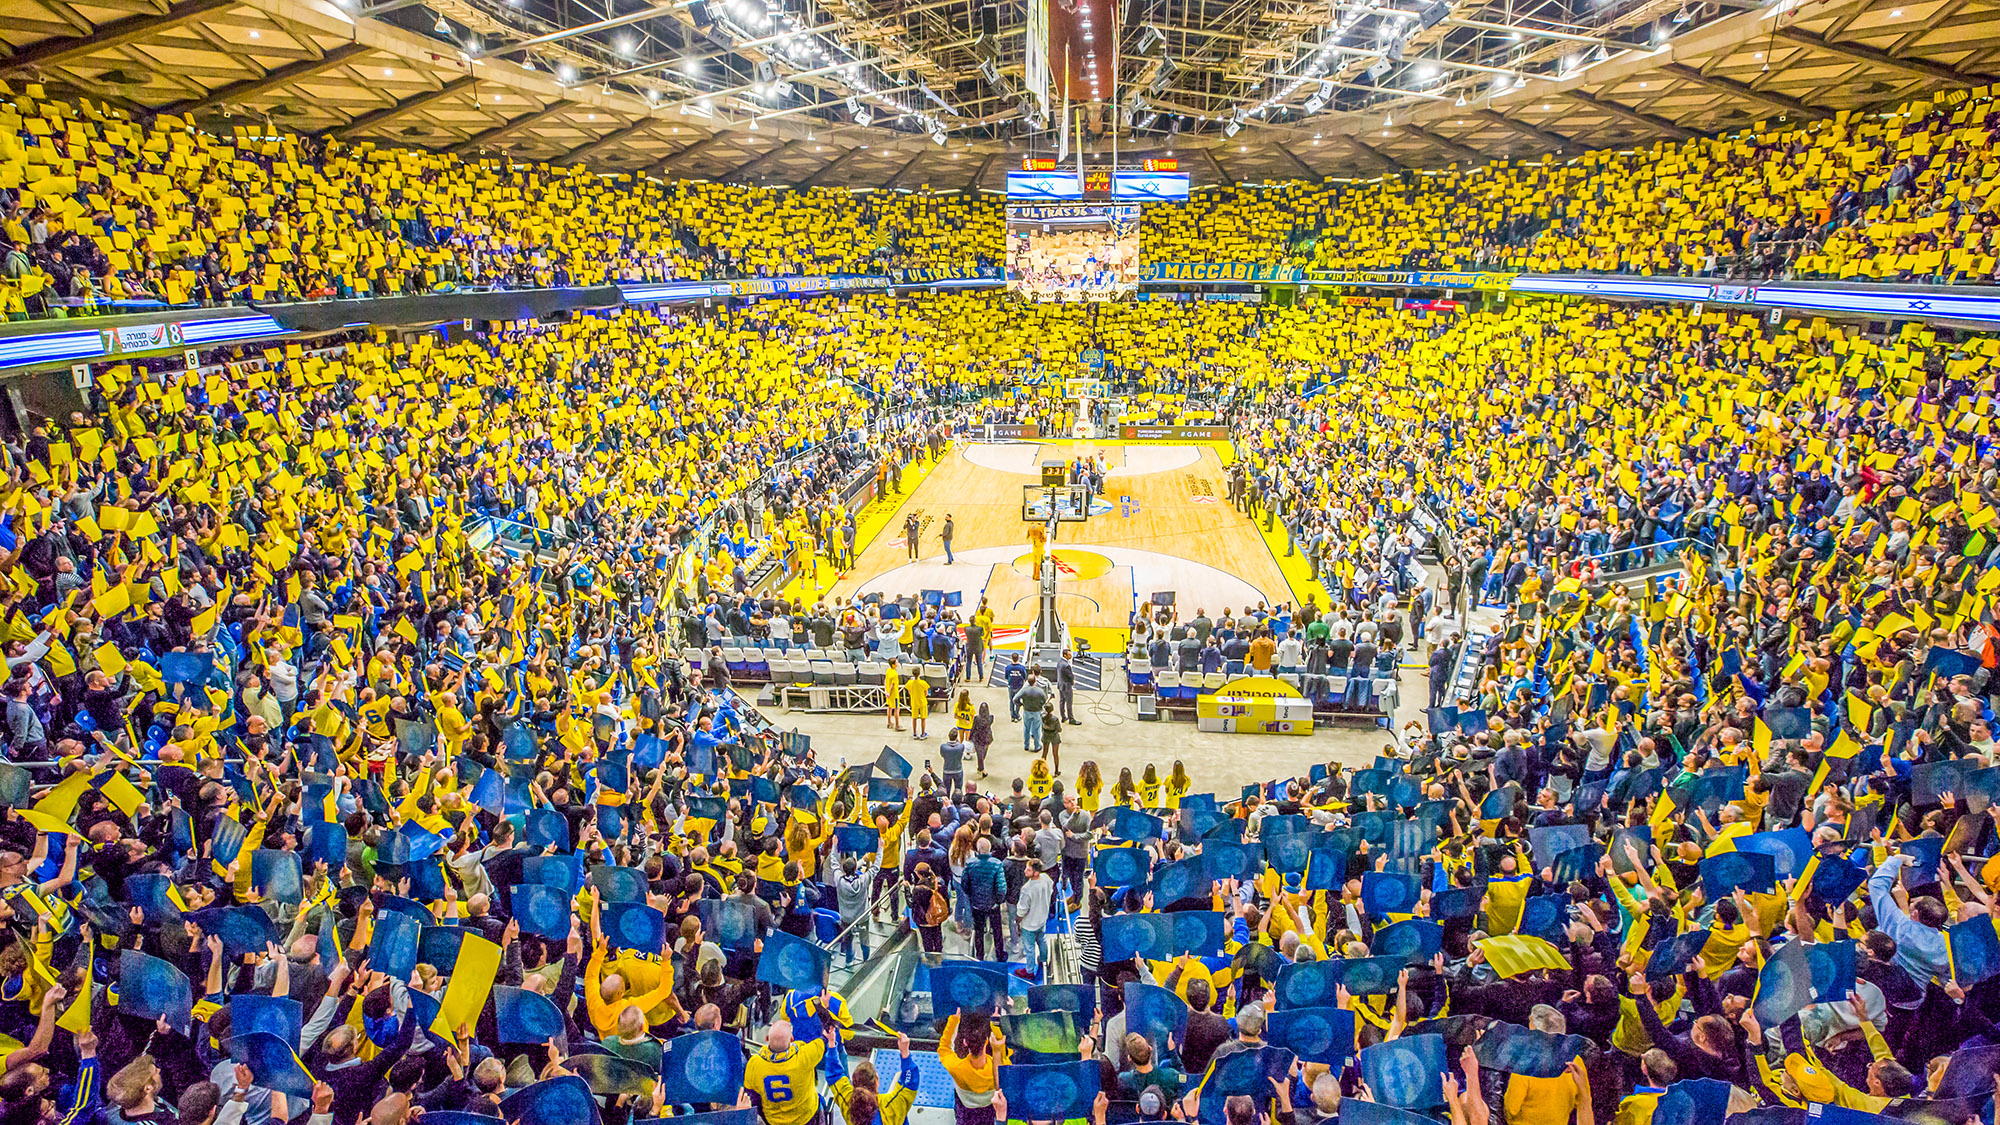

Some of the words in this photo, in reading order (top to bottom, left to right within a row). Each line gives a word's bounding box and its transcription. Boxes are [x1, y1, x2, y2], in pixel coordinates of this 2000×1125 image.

[1022, 208, 1071, 218] ULTRAS
[908, 266, 961, 282] ULTRAS
[963, 267, 979, 279] 96
[1165, 263, 1254, 280] MACCABI
[1709, 286, 1717, 300] 2
[1747, 288, 1756, 302] 3
[1695, 304, 1700, 314] 2
[1773, 311, 1779, 321] 3
[169, 324, 181, 344] 8
[102, 330, 115, 353] 7
[121, 340, 149, 348] מבטחים
[189, 353, 196, 365] 8
[77, 369, 85, 383] 7
[366, 710, 380, 724] 6
[764, 1075, 793, 1102] 6
